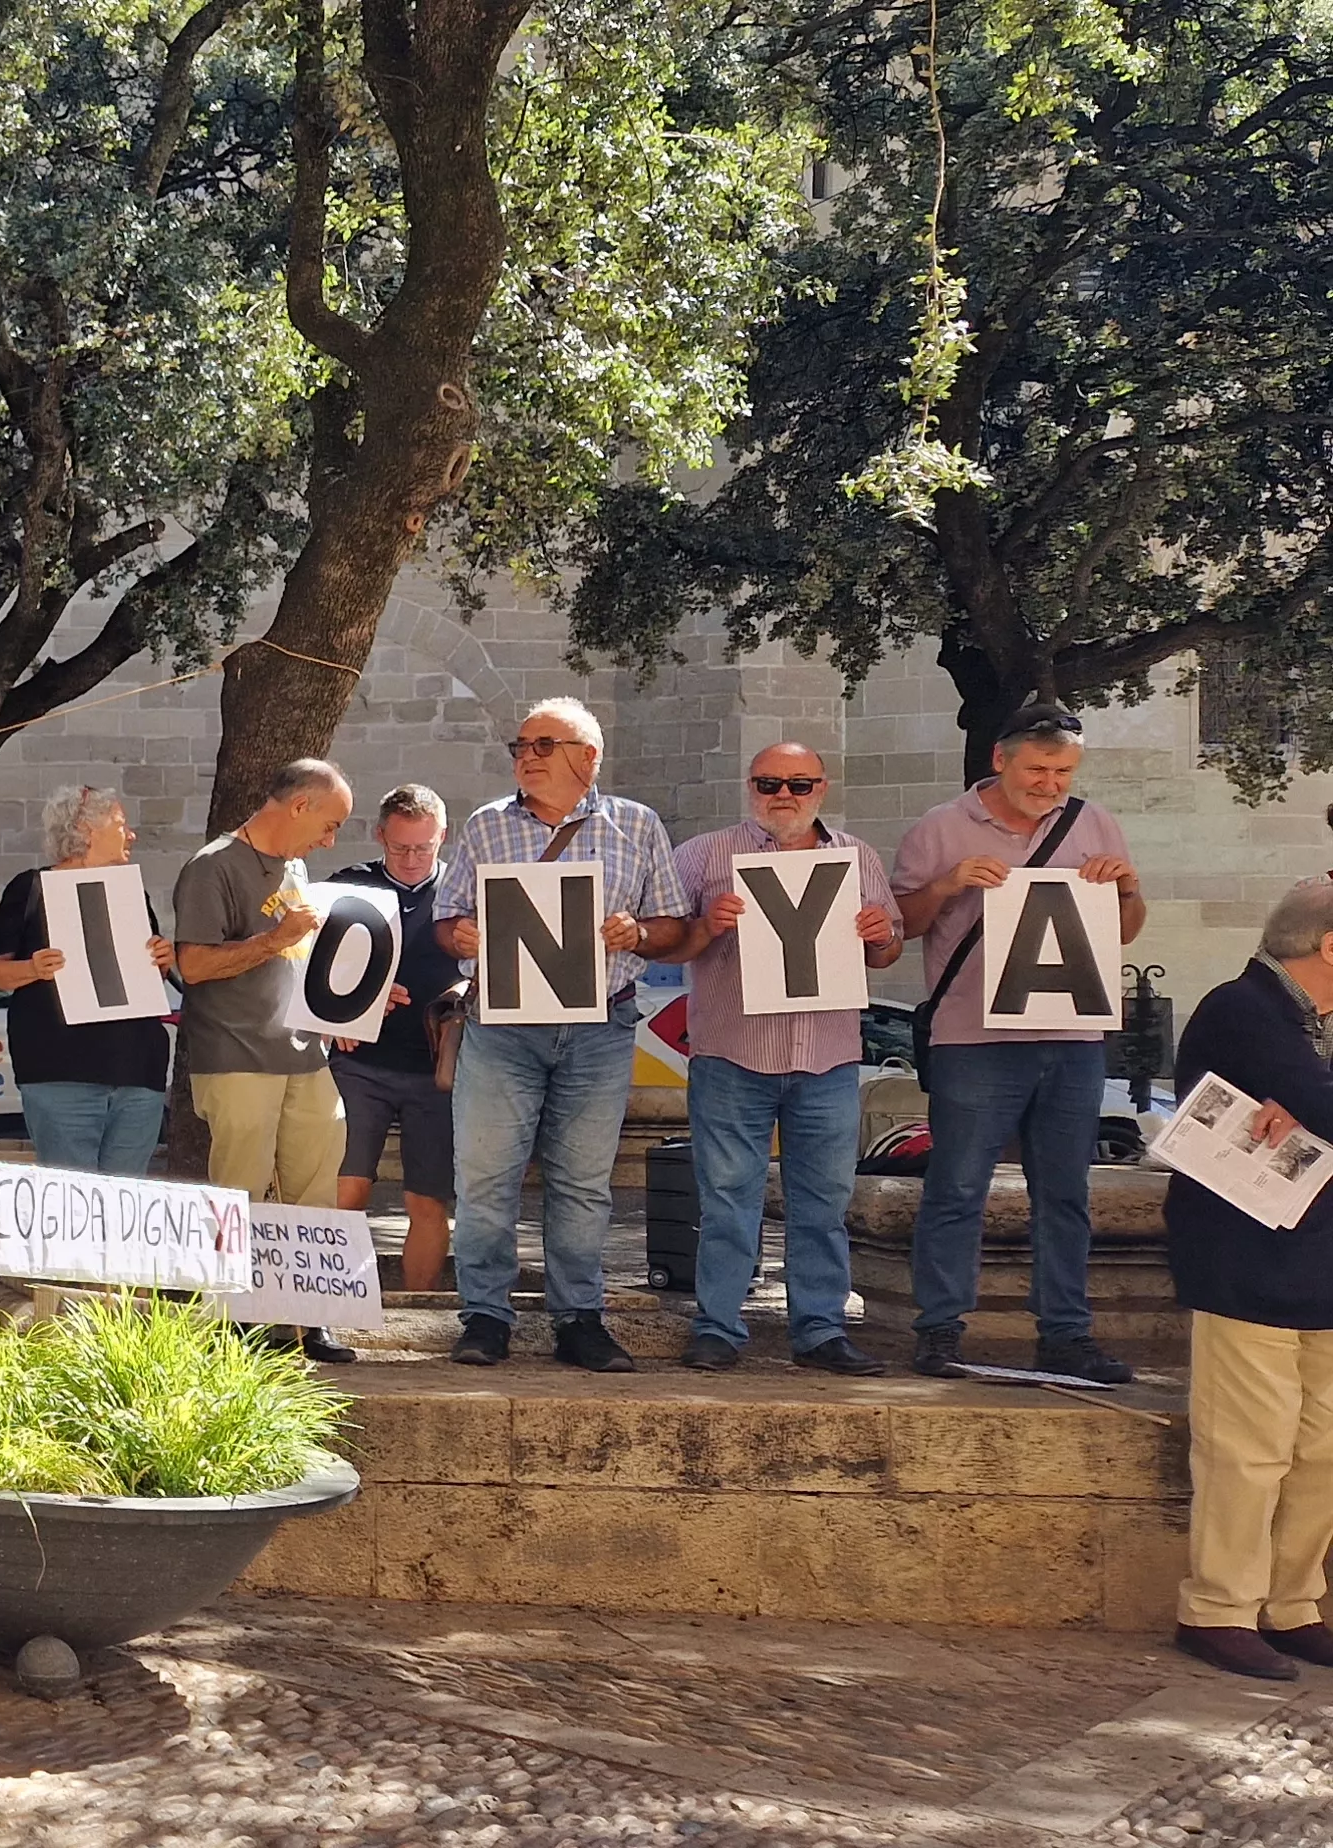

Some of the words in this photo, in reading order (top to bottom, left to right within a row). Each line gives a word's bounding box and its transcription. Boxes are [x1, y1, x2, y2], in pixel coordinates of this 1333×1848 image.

[118, 1189, 203, 1249] DIGNA
[250, 1222, 290, 1241] NEN
[297, 1225, 348, 1246] RICOS
[296, 1251, 310, 1269] SI
[321, 1253, 351, 1275] NO,
[275, 1273, 284, 1290] Y
[293, 1273, 367, 1298] RACISMO
